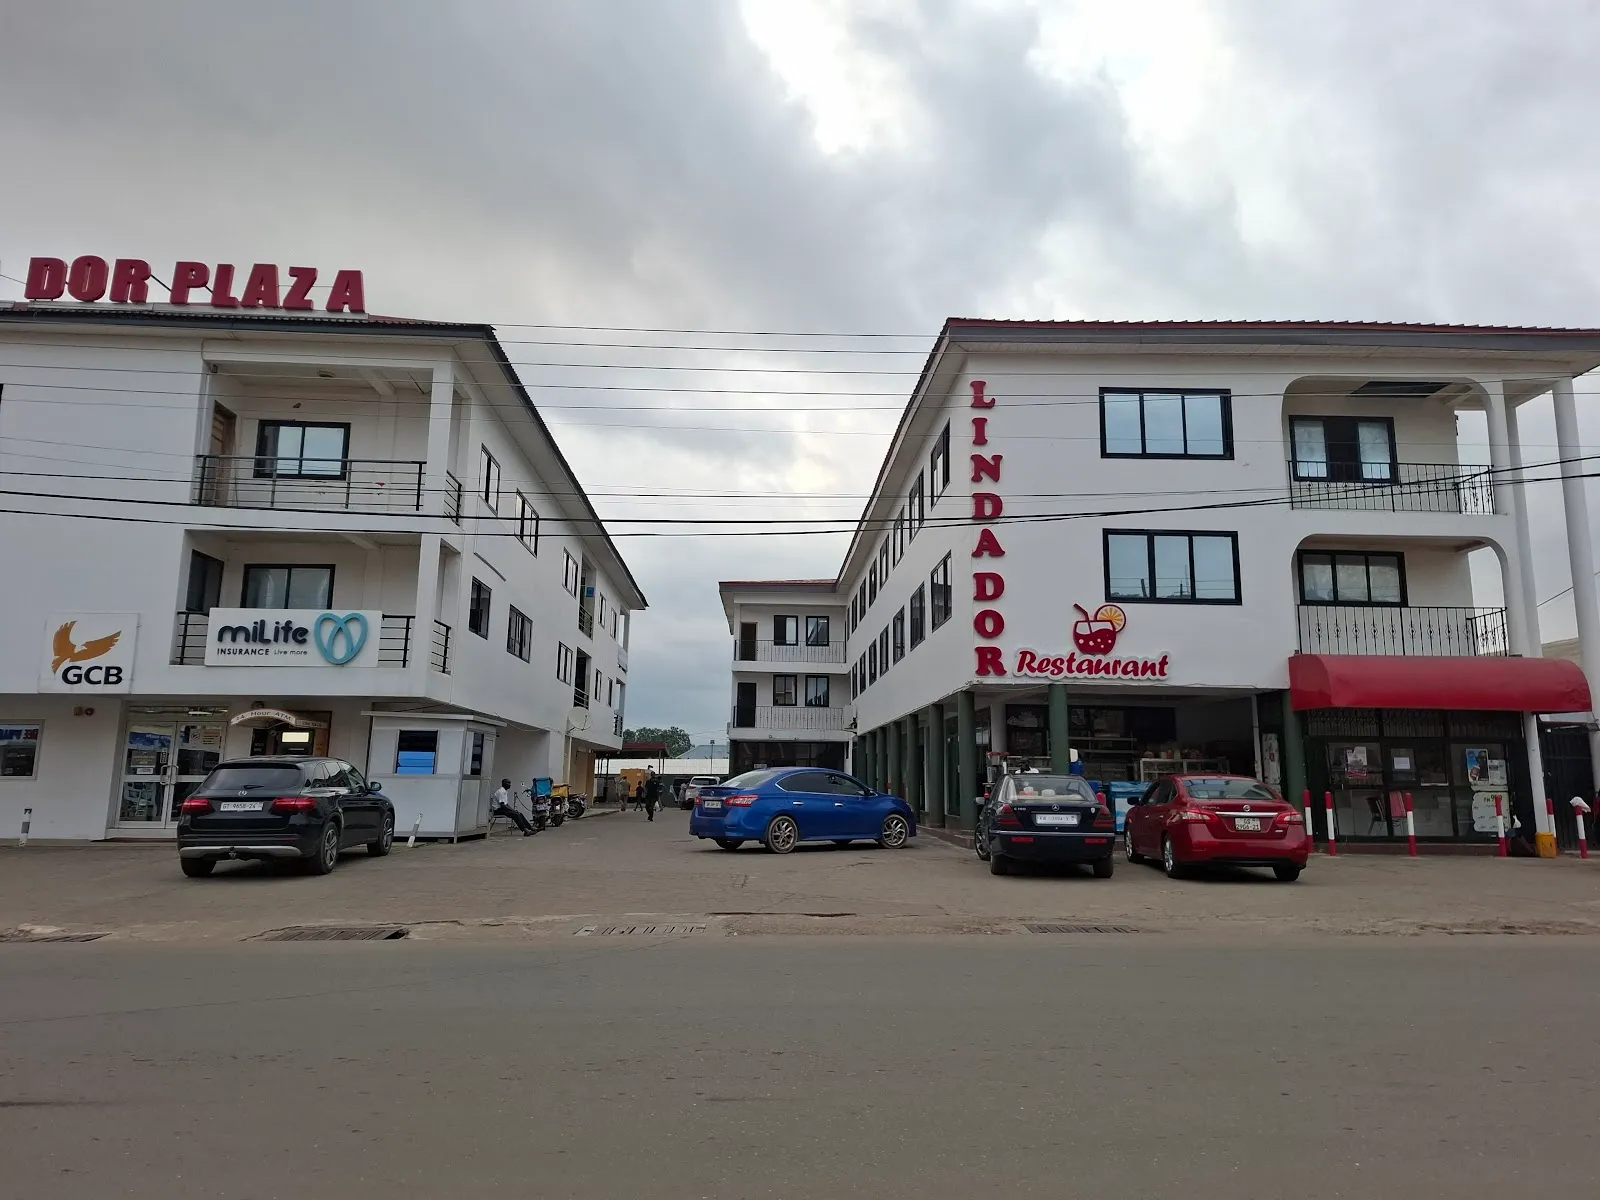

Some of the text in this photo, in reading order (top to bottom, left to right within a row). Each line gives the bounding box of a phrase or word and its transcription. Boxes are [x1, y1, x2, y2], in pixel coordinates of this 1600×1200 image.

[24, 255, 366, 313] DOR PLAZA
[217, 619, 309, 644] miLife
[217, 648, 270, 656] INSURANCE
[1016, 650, 1169, 677] Restaurant
[61, 665, 123, 685] GCB
[274, 711, 292, 721] ATM
